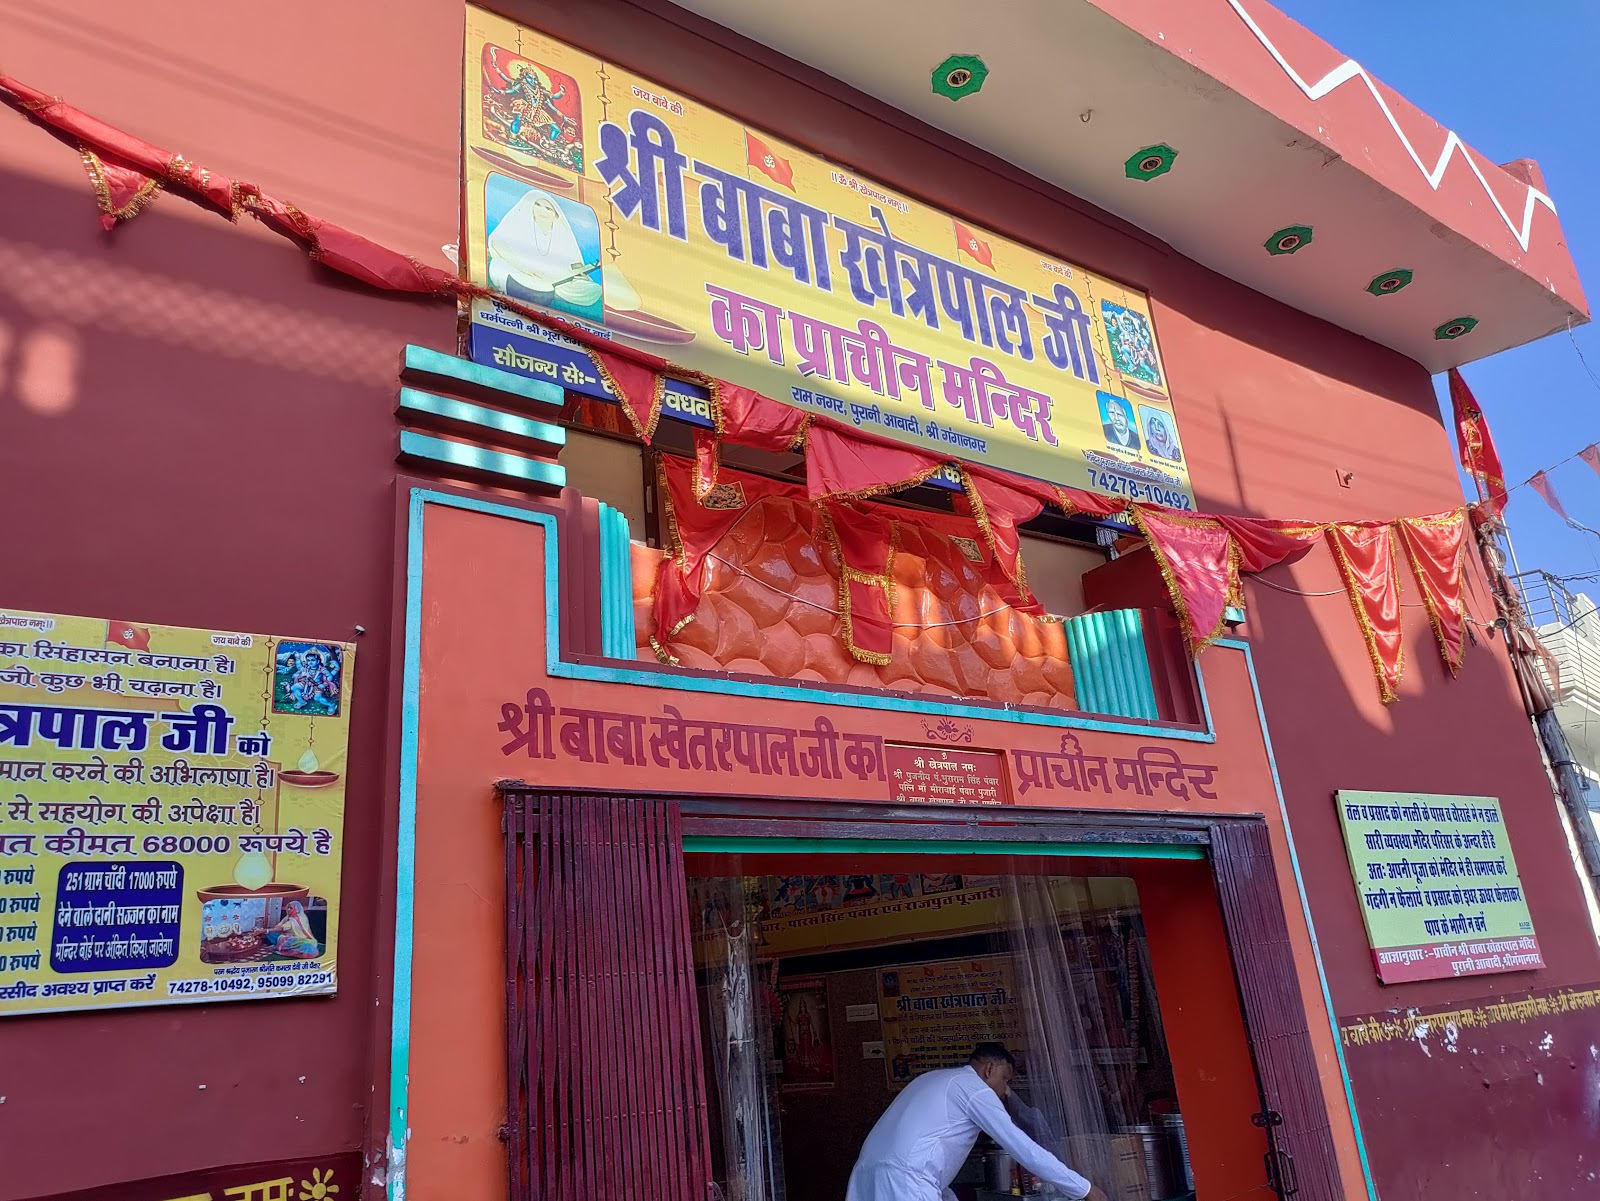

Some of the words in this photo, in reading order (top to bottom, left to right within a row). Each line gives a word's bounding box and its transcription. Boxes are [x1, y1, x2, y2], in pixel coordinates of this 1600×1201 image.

[594, 109, 690, 241] श्री
[693, 160, 832, 292] बाबा
[833, 205, 1035, 361] खेत्रपाल
[1032, 283, 1101, 385] जी
[480, 310, 523, 331] धर्मपत्नी
[525, 322, 540, 335] श्री
[542, 329, 560, 343] भूरा
[492, 343, 559, 379] सौजन्य
[705, 282, 784, 366] का
[787, 310, 934, 410] प्राचीन
[937, 357, 1059, 446] मन्दिर
[791, 386, 812, 404] राम
[815, 393, 847, 416] नगर,
[850, 403, 881, 426] पुरानी
[925, 421, 940, 440] श्री
[942, 427, 987, 453] गंगानगर
[1087, 468, 1192, 511] 74278-10492
[213, 636, 226, 645] जय
[241, 636, 251, 646] की
[33, 640, 133, 666] सिंहासन
[138, 653, 214, 673] बनाना
[0, 666, 36, 687] जो
[39, 673, 86, 692] कुछ
[92, 672, 125, 693] भी
[129, 679, 198, 698] चढ़ाना
[161, 704, 234, 755] जी
[237, 731, 272, 756] को
[497, 688, 557, 760] श्री
[559, 707, 647, 767] बाबा
[649, 704, 800, 778] खेतरपाल
[800, 716, 843, 780] जी
[842, 733, 887, 782] का
[1011, 731, 1113, 796] प्राचीन
[51, 755, 110, 784] करने
[113, 757, 147, 785] की
[150, 759, 252, 788] अभिलाषा
[893, 769, 902, 780] श्री
[913, 757, 925, 769] श्री
[928, 758, 958, 771] खेत्रपाल
[8, 793, 34, 823] से
[38, 795, 128, 826] सहयोग
[132, 796, 164, 825] की
[167, 797, 237, 825] अपेक्षा
[1367, 805, 1390, 821] प्रसाद
[1401, 802, 1422, 821] नाली
[44, 827, 138, 856] कीमत
[143, 836, 230, 853] 68000
[238, 829, 311, 856] रूपये
[312, 828, 333, 854] है
[1364, 829, 1384, 849] सारी
[4, 864, 36, 885] रुपये
[65, 872, 83, 891] 251
[84, 871, 103, 891] ग्राम
[129, 871, 154, 890] 17000
[156, 864, 178, 889] रुपये
[1386, 858, 1412, 878] अपनी
[9, 892, 41, 913] रुपये
[57, 902, 72, 927] देने
[73, 900, 93, 927] वाले
[94, 900, 116, 926] दानी
[117, 905, 146, 925] सज्जन
[147, 904, 161, 924] का
[162, 904, 179, 924] नाम
[6, 920, 38, 942] रुपये
[1424, 919, 1441, 936] पाप
[9, 949, 41, 971] रुपये
[94, 942, 105, 958] पर
[42, 982, 90, 997] अवश्य
[93, 979, 126, 996] प्राप्त
[130, 972, 157, 991] करें
[258, 975, 294, 989] 95099
[298, 972, 332, 986] 82291
[913, 996, 938, 1011] बाबा
